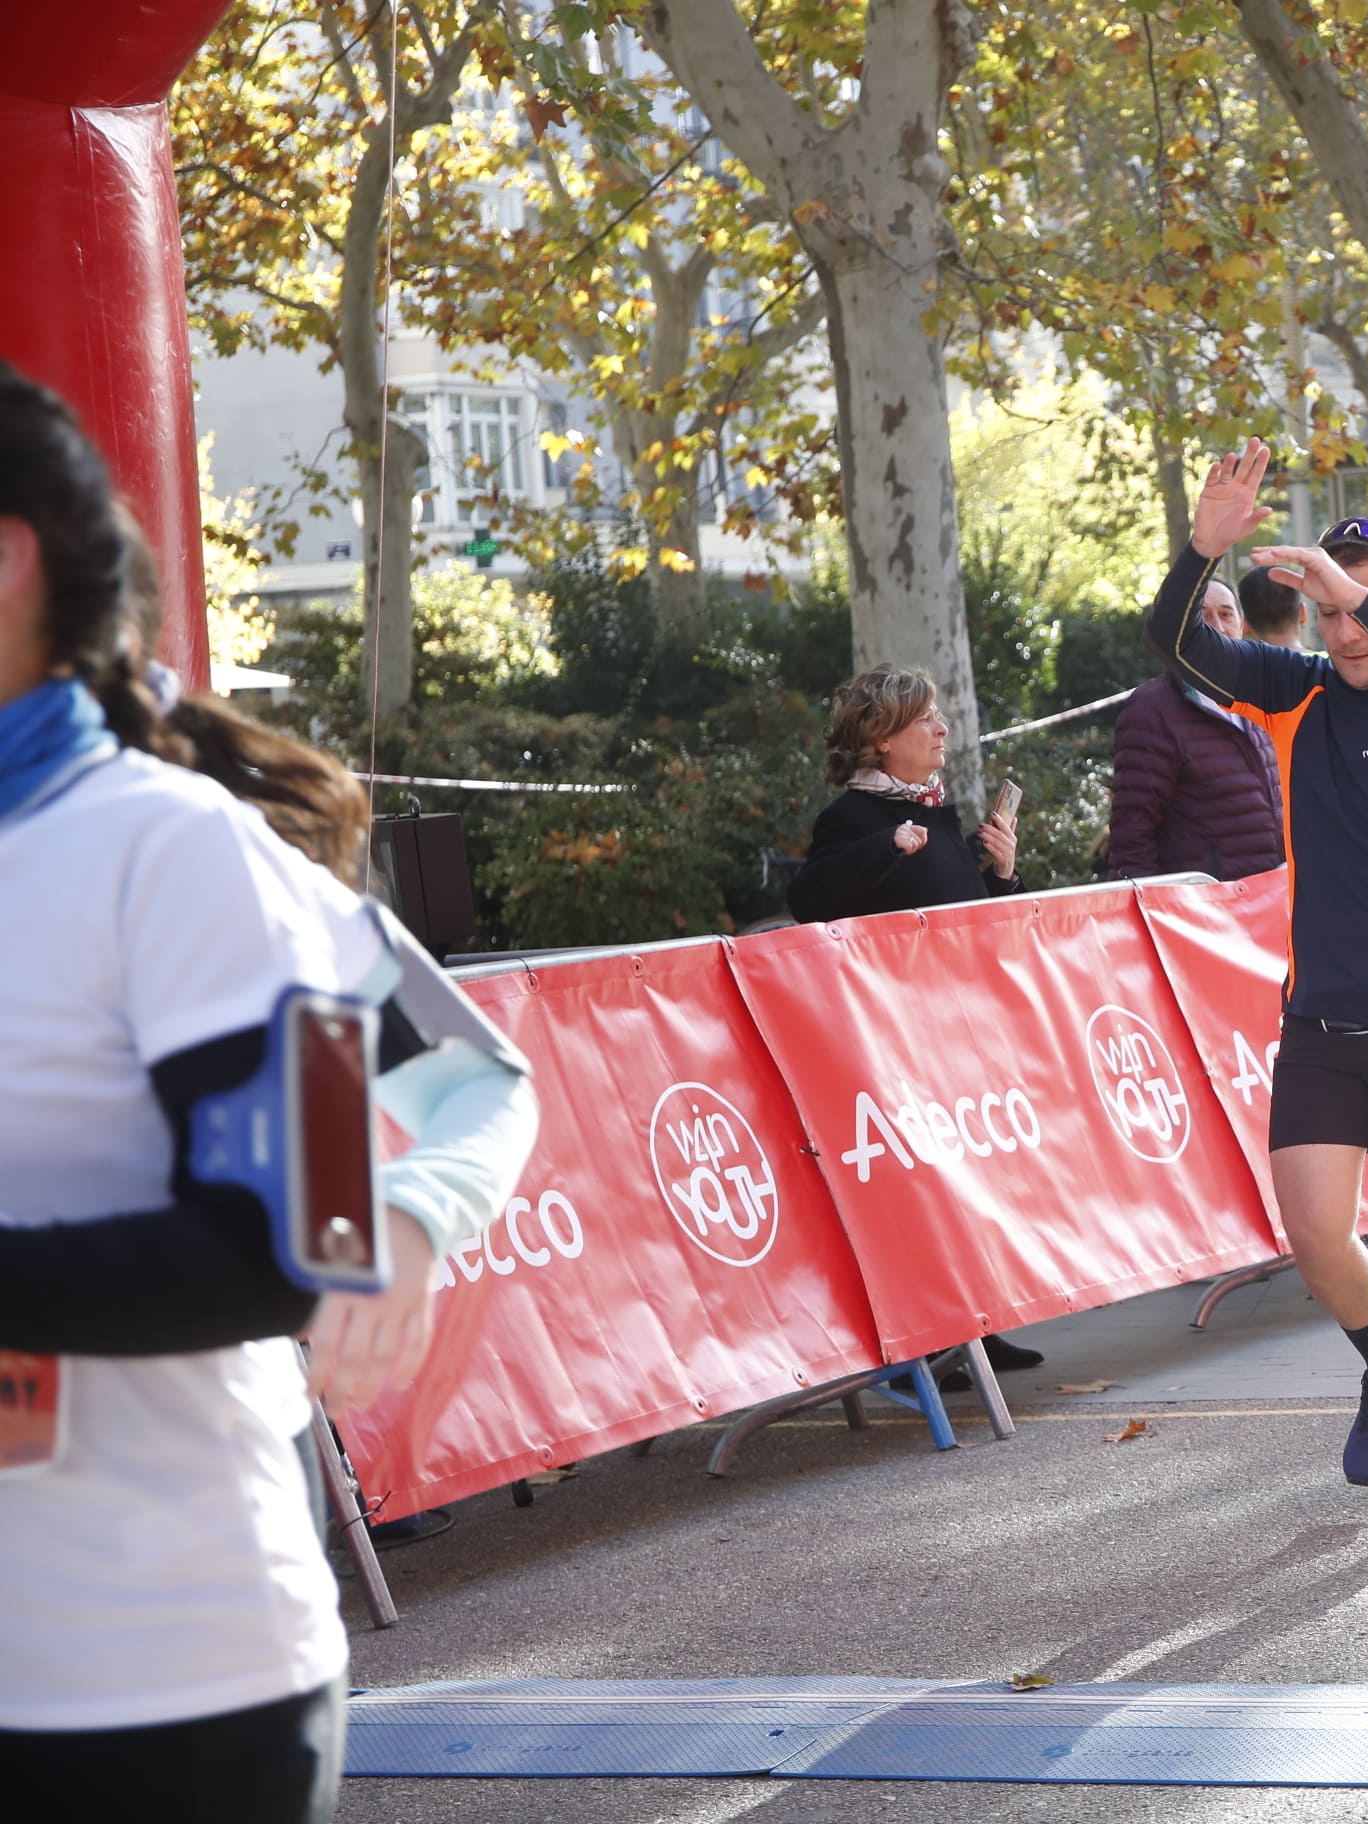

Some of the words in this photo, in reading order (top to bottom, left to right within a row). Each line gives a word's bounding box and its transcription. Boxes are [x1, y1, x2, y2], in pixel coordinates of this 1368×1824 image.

[841, 1080, 1040, 1183] Adecco
[1105, 1074, 1186, 1142] YOUTH
[671, 1159, 777, 1240] YOUTH
